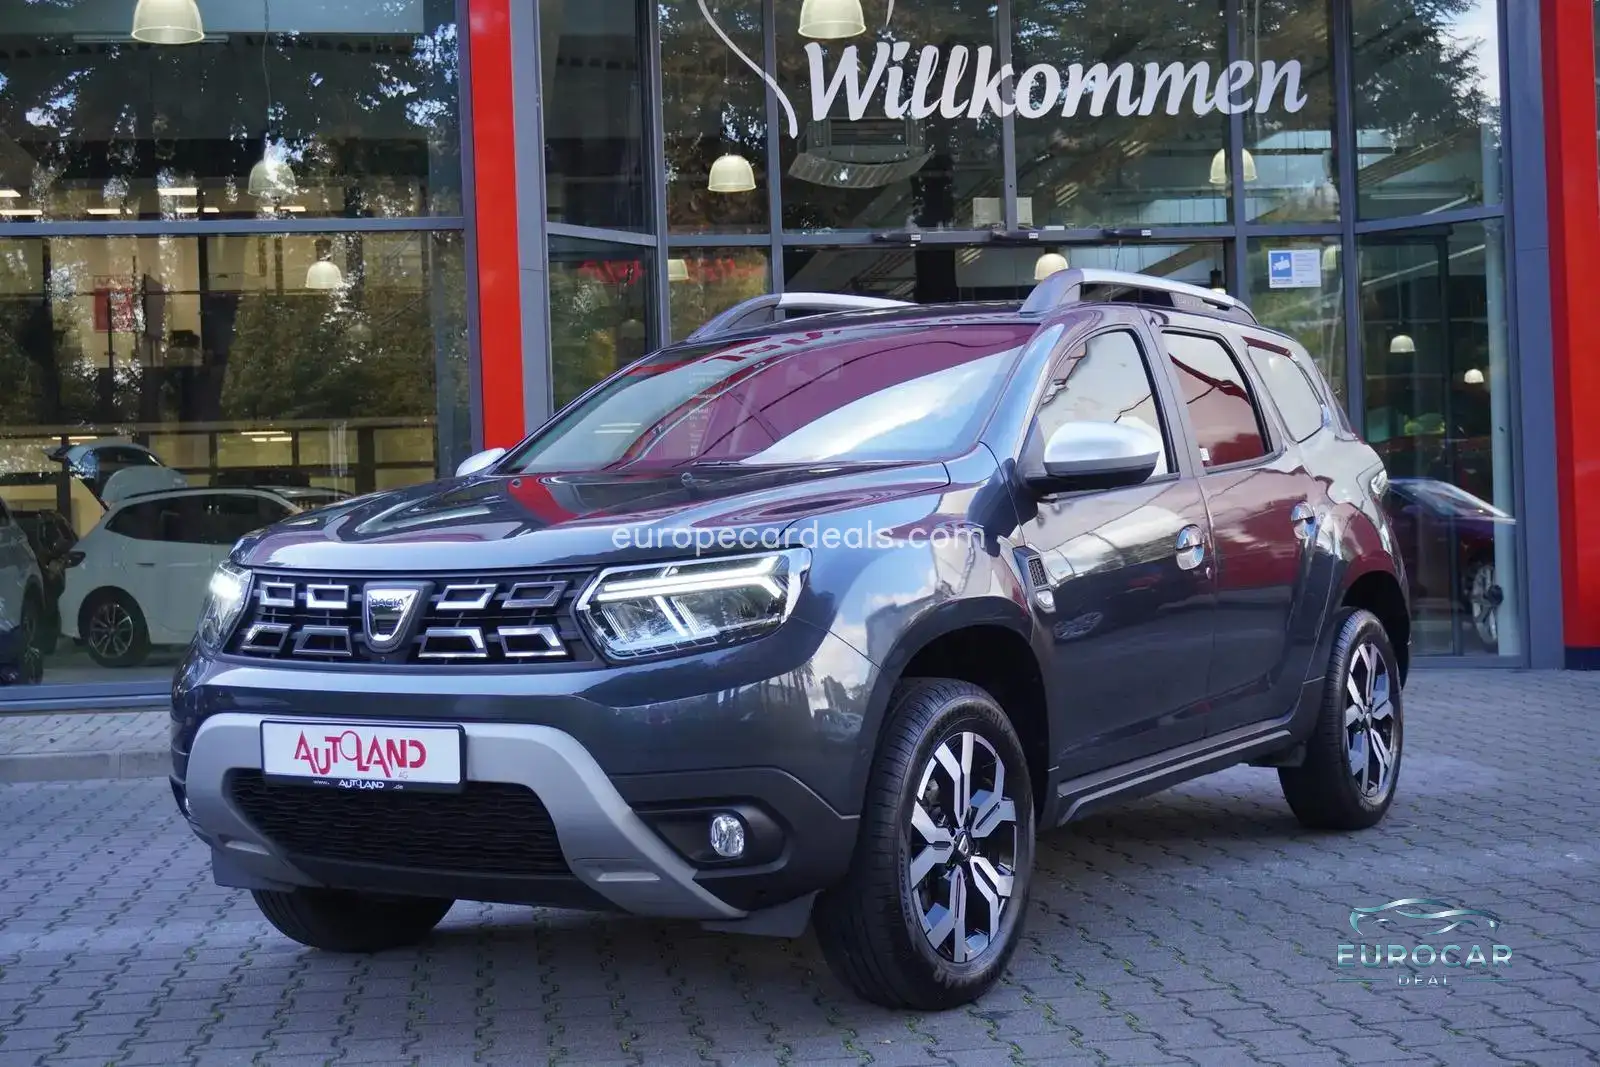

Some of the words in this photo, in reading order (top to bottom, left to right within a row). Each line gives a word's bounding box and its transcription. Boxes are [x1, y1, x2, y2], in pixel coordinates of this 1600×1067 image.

[803, 41, 1308, 121] Willkommen
[370, 598, 405, 607] DACIA
[294, 730, 427, 778] AUTOLAND
[338, 779, 385, 790] AUTOLAND
